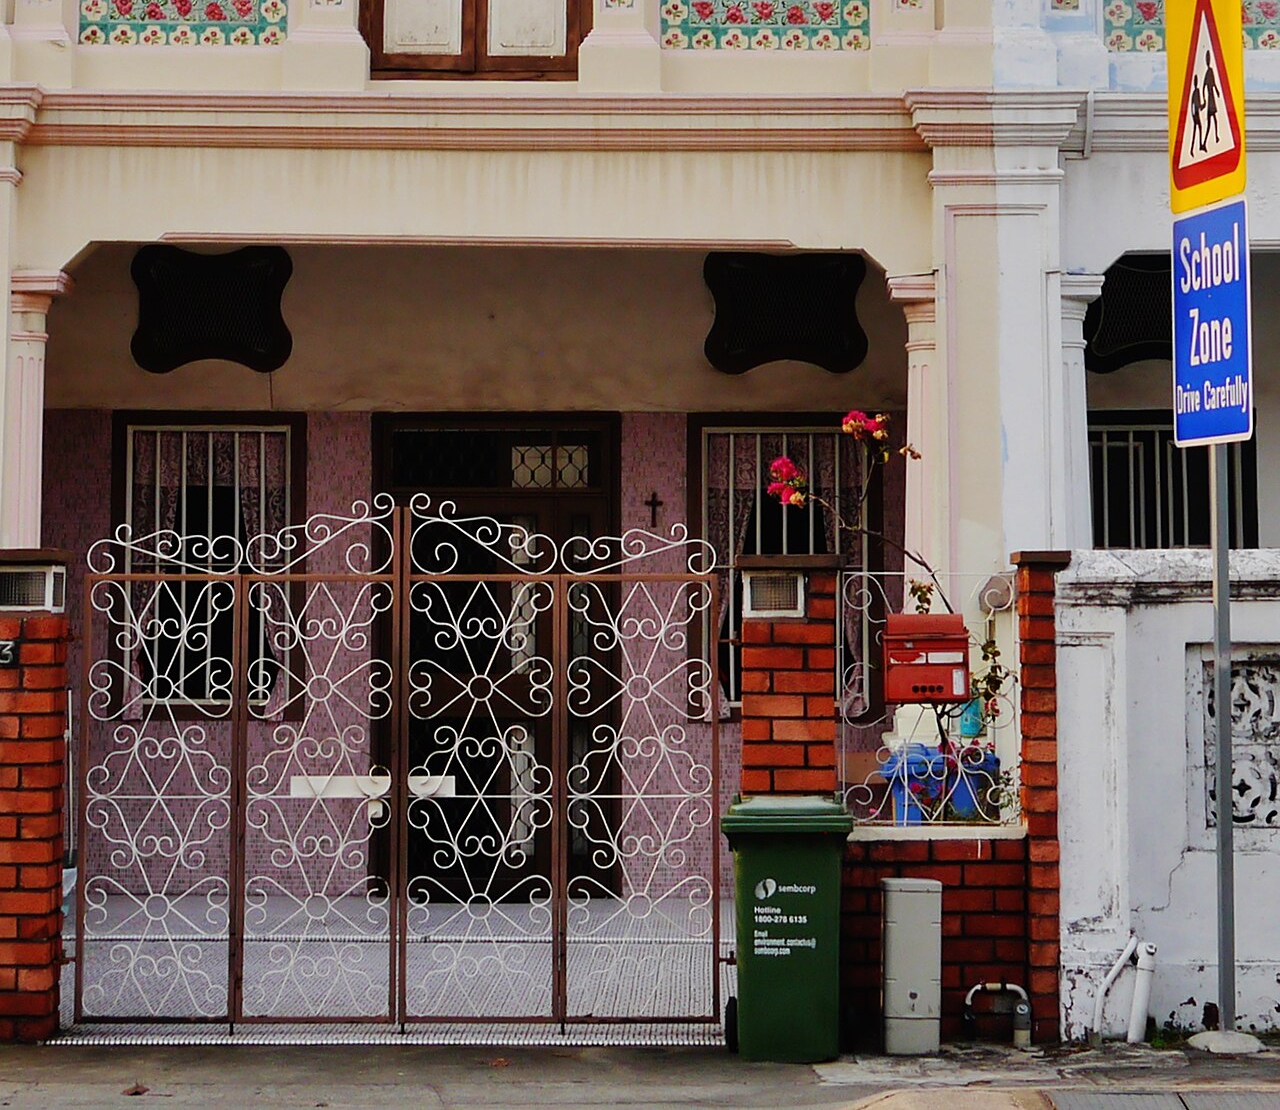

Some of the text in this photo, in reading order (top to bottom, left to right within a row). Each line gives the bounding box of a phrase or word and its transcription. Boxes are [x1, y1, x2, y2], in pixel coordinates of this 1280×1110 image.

[1180, 222, 1240, 294] School
[1189, 307, 1233, 367] Zone
[1177, 374, 1248, 415] Drive Carefully
[778, 883, 817, 895] sembcorp
[754, 906, 782, 914] Hotline
[789, 915, 808, 924] 6135
